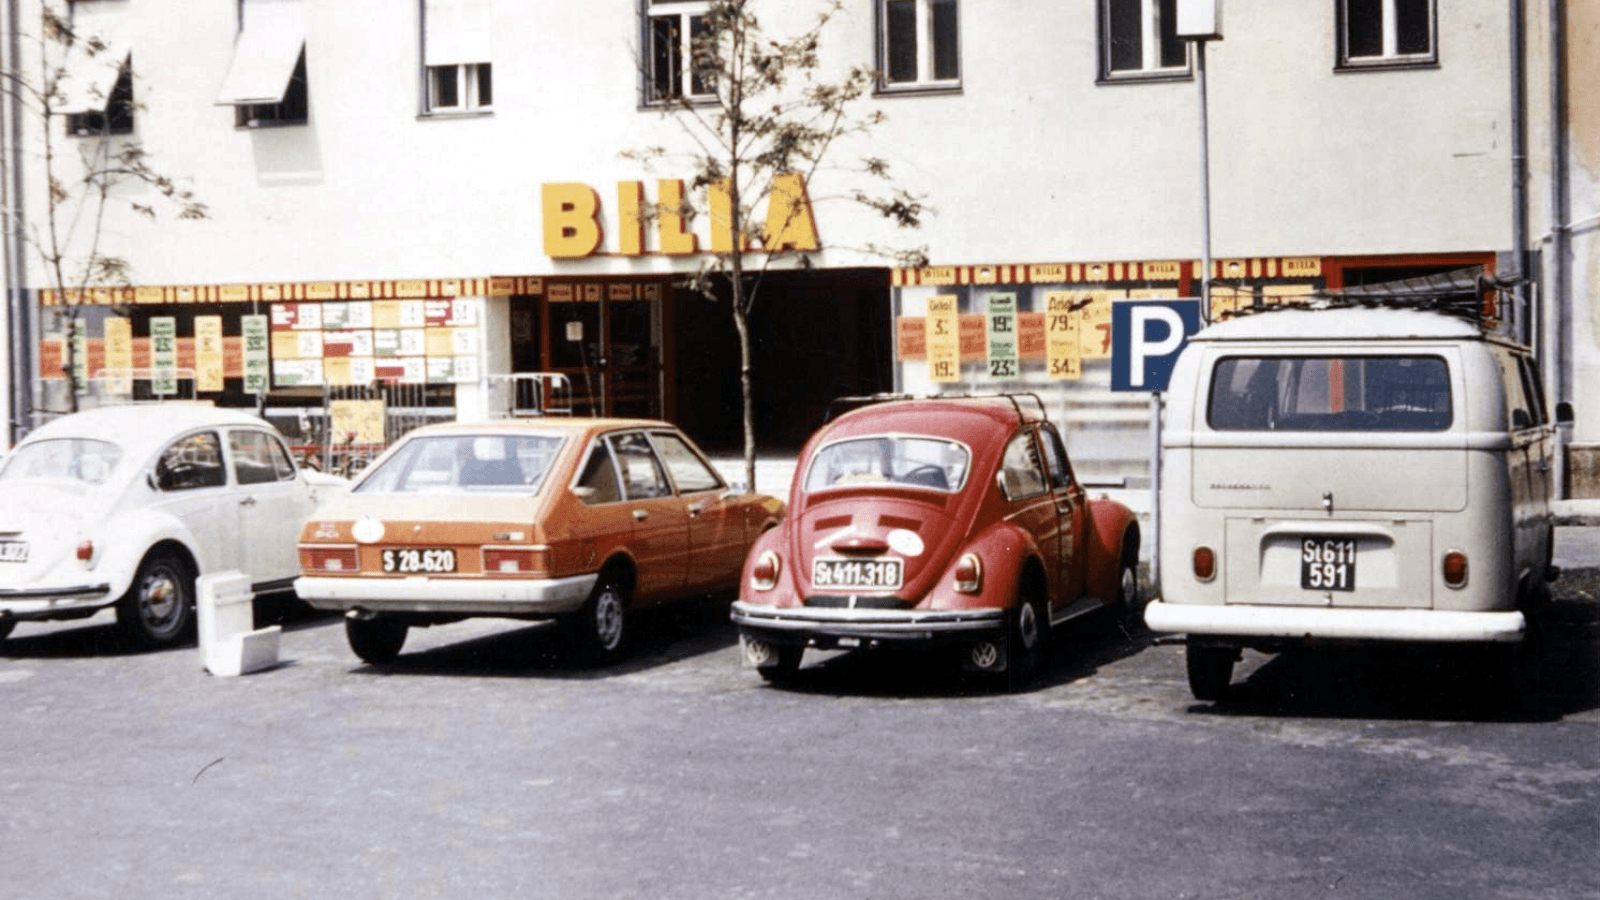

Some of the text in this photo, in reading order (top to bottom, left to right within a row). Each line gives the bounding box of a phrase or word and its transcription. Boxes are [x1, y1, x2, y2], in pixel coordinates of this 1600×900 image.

[541, 173, 822, 260] BILLA
[1130, 305, 1184, 387] P
[1310, 562, 1347, 588] 591
